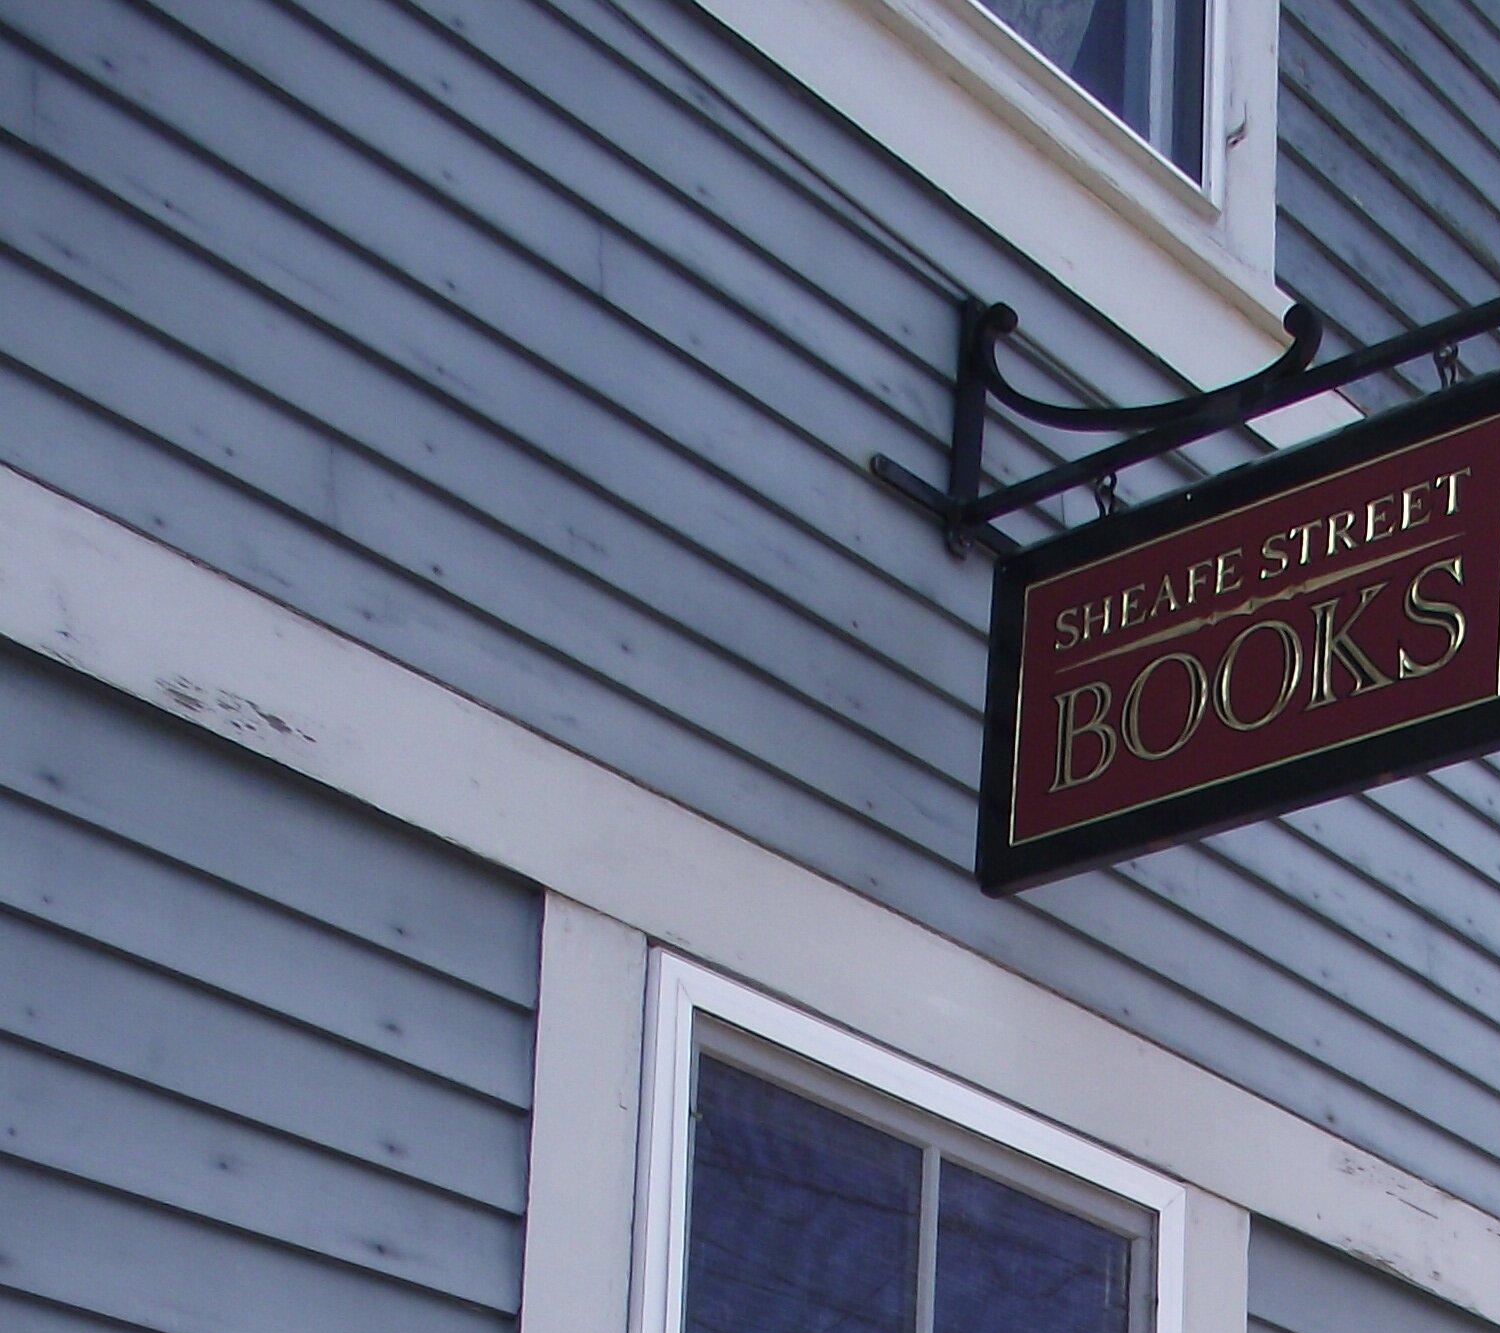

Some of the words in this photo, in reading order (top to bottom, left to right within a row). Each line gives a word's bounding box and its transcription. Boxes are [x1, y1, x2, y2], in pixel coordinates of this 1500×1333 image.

[1054, 546, 1245, 652] SHEAFE
[1259, 466, 1473, 582] STREET
[1047, 556, 1468, 795] BOOKS
